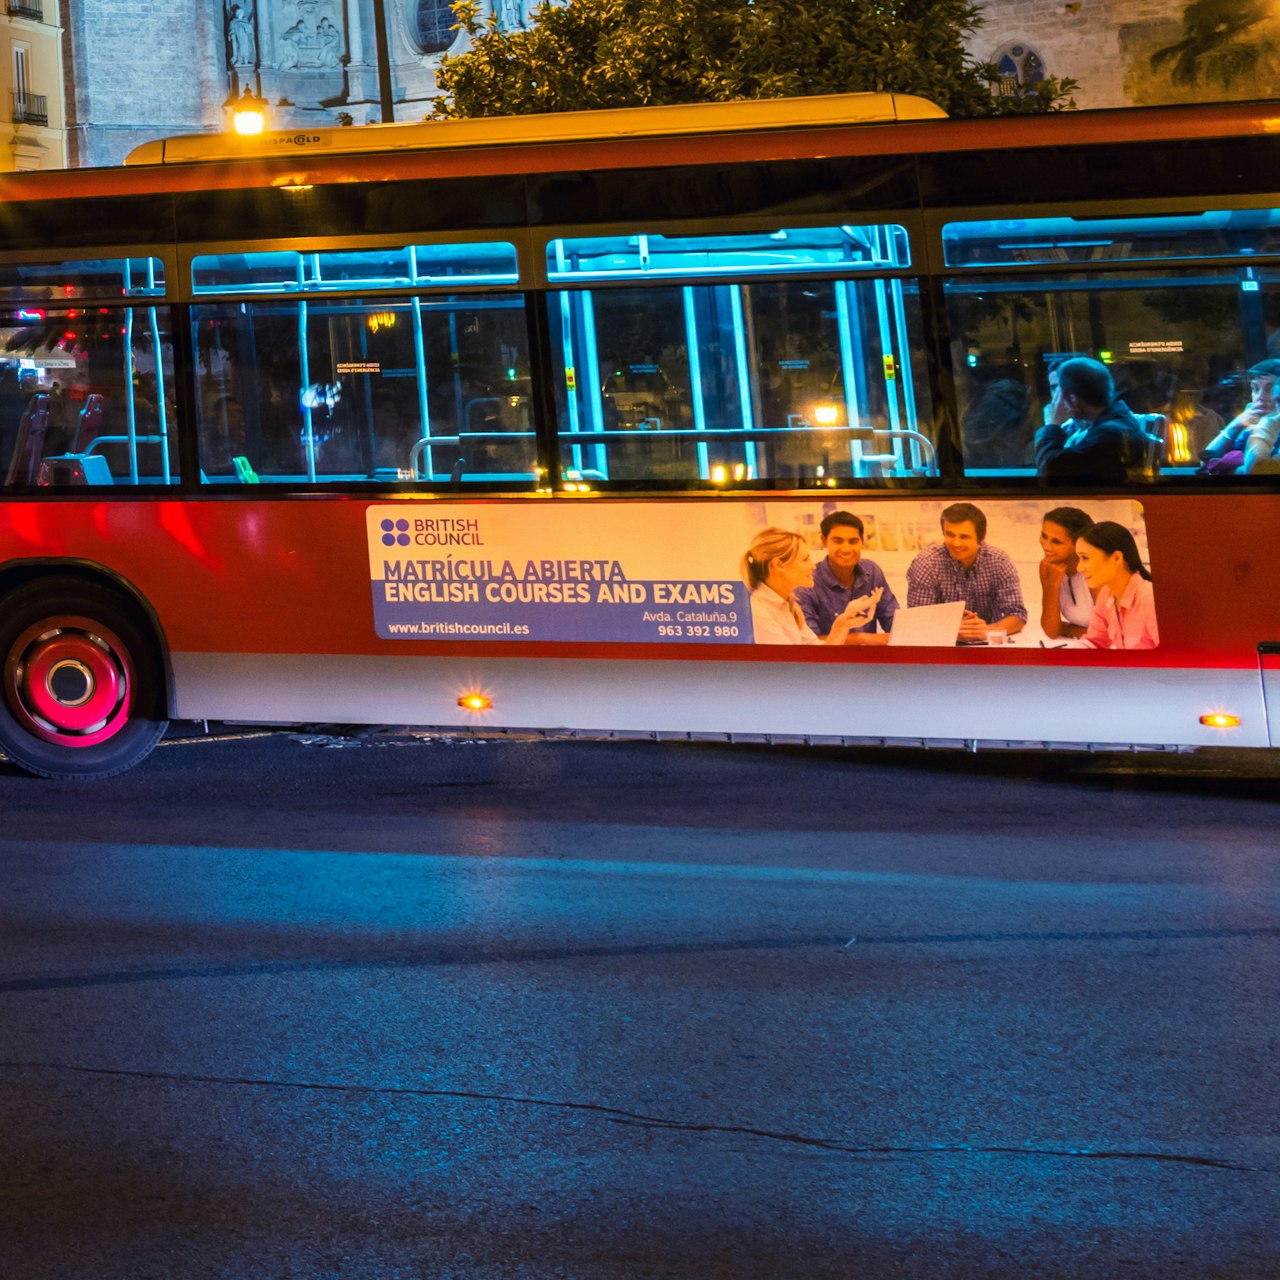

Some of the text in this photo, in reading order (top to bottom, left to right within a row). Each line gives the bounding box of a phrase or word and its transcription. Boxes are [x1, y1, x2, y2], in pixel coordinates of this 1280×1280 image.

[414, 519, 478, 532] BRITISH
[415, 533, 484, 546] COUNCIL
[384, 554, 627, 581] MATRÍCULA ABIERTA
[384, 583, 735, 604] ENGLISH COURSES AND EXAMS
[642, 611, 737, 623] Avda. Cataluña,9
[388, 622, 530, 635] www.britishcouncil.es
[658, 626, 739, 637] 963 392 980
